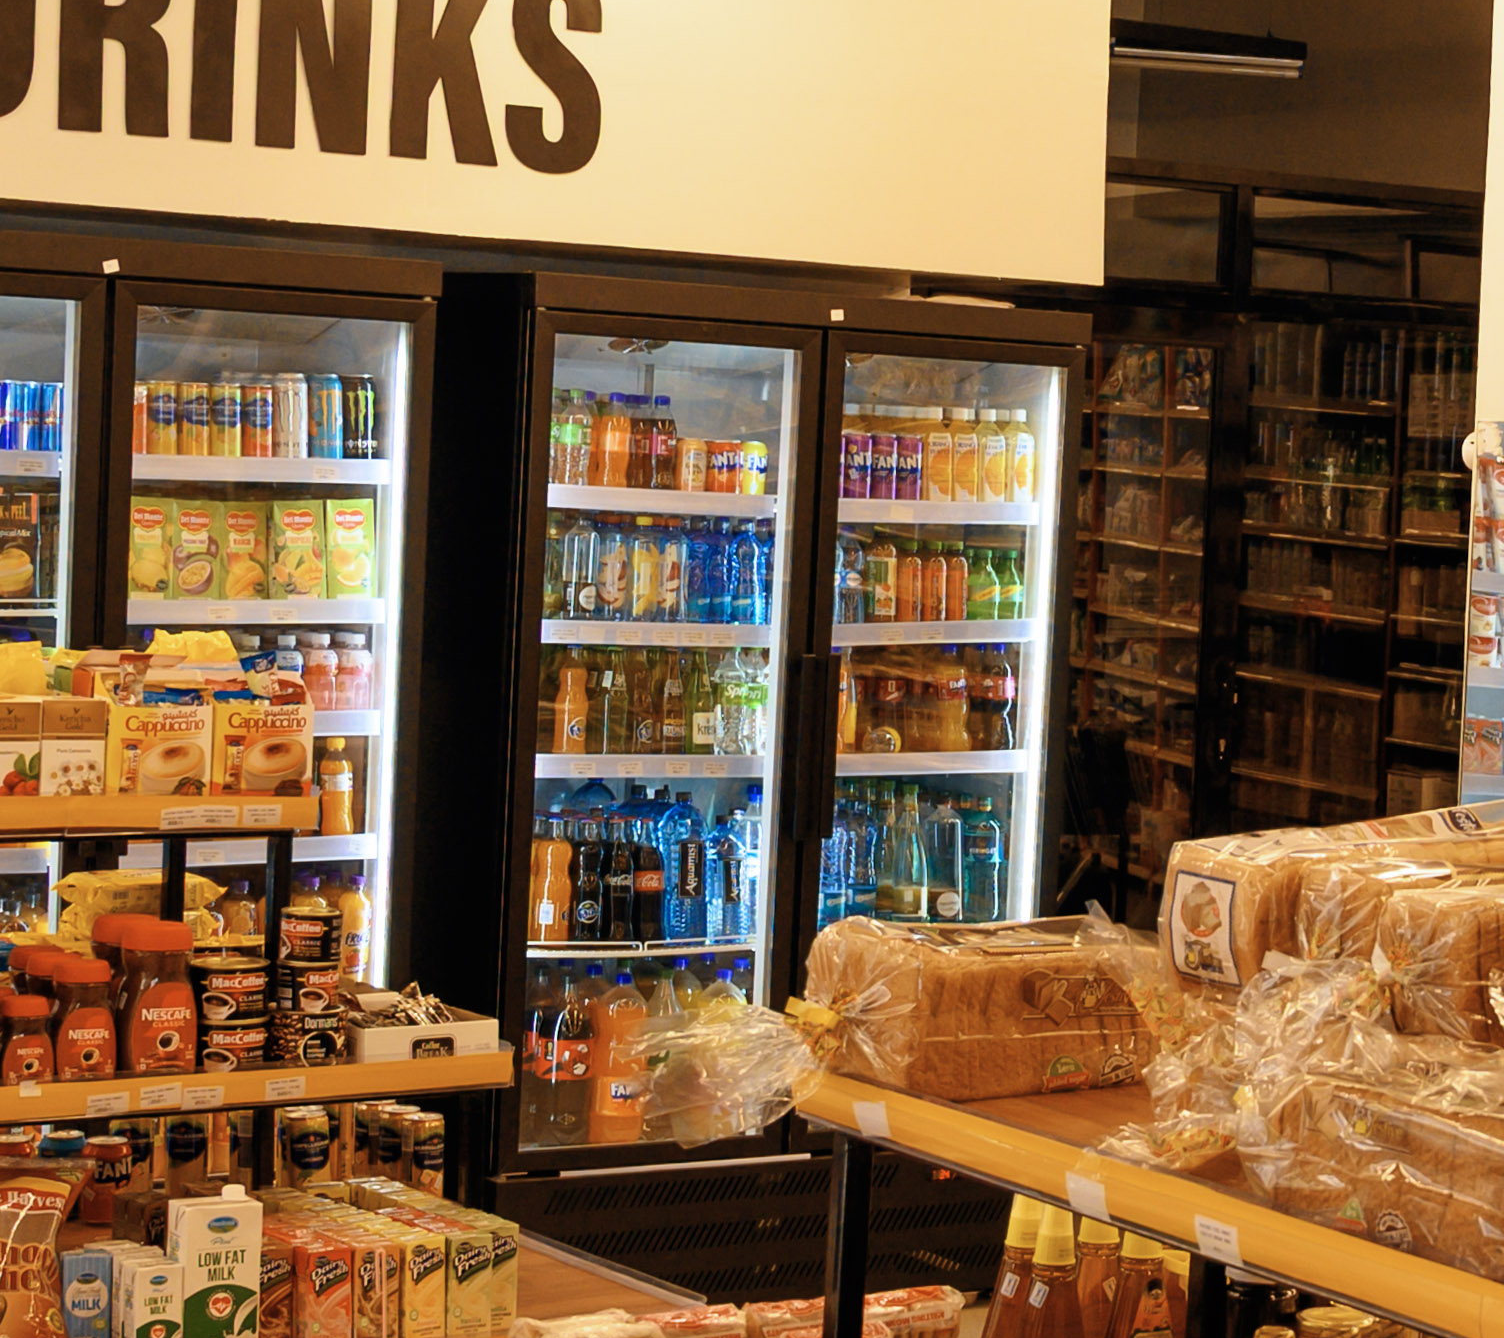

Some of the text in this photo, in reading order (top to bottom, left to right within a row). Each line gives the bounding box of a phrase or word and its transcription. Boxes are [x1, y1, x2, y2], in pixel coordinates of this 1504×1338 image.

[125, 715, 205, 737] Cappuccino
[228, 713, 306, 733] Cappuccino
[684, 843, 698, 896] Aquamist
[605, 874, 633, 887] Coca-Cola
[212, 974, 266, 990] MacCoffee
[212, 1032, 266, 1046] MacCoffee
[7, 1187, 64, 1210] Harvest
[198, 1249, 246, 1267] LOW FAT
[409, 1248, 441, 1269] Dairy
[412, 1254, 444, 1279] Fresh
[208, 1266, 235, 1282] MILK
[311, 1258, 346, 1280] Dairy
[314, 1264, 349, 1288] Fresh
[72, 1299, 101, 1311] MILK
[144, 1297, 173, 1308] LOW FAT
[150, 1305, 167, 1315] MILK
